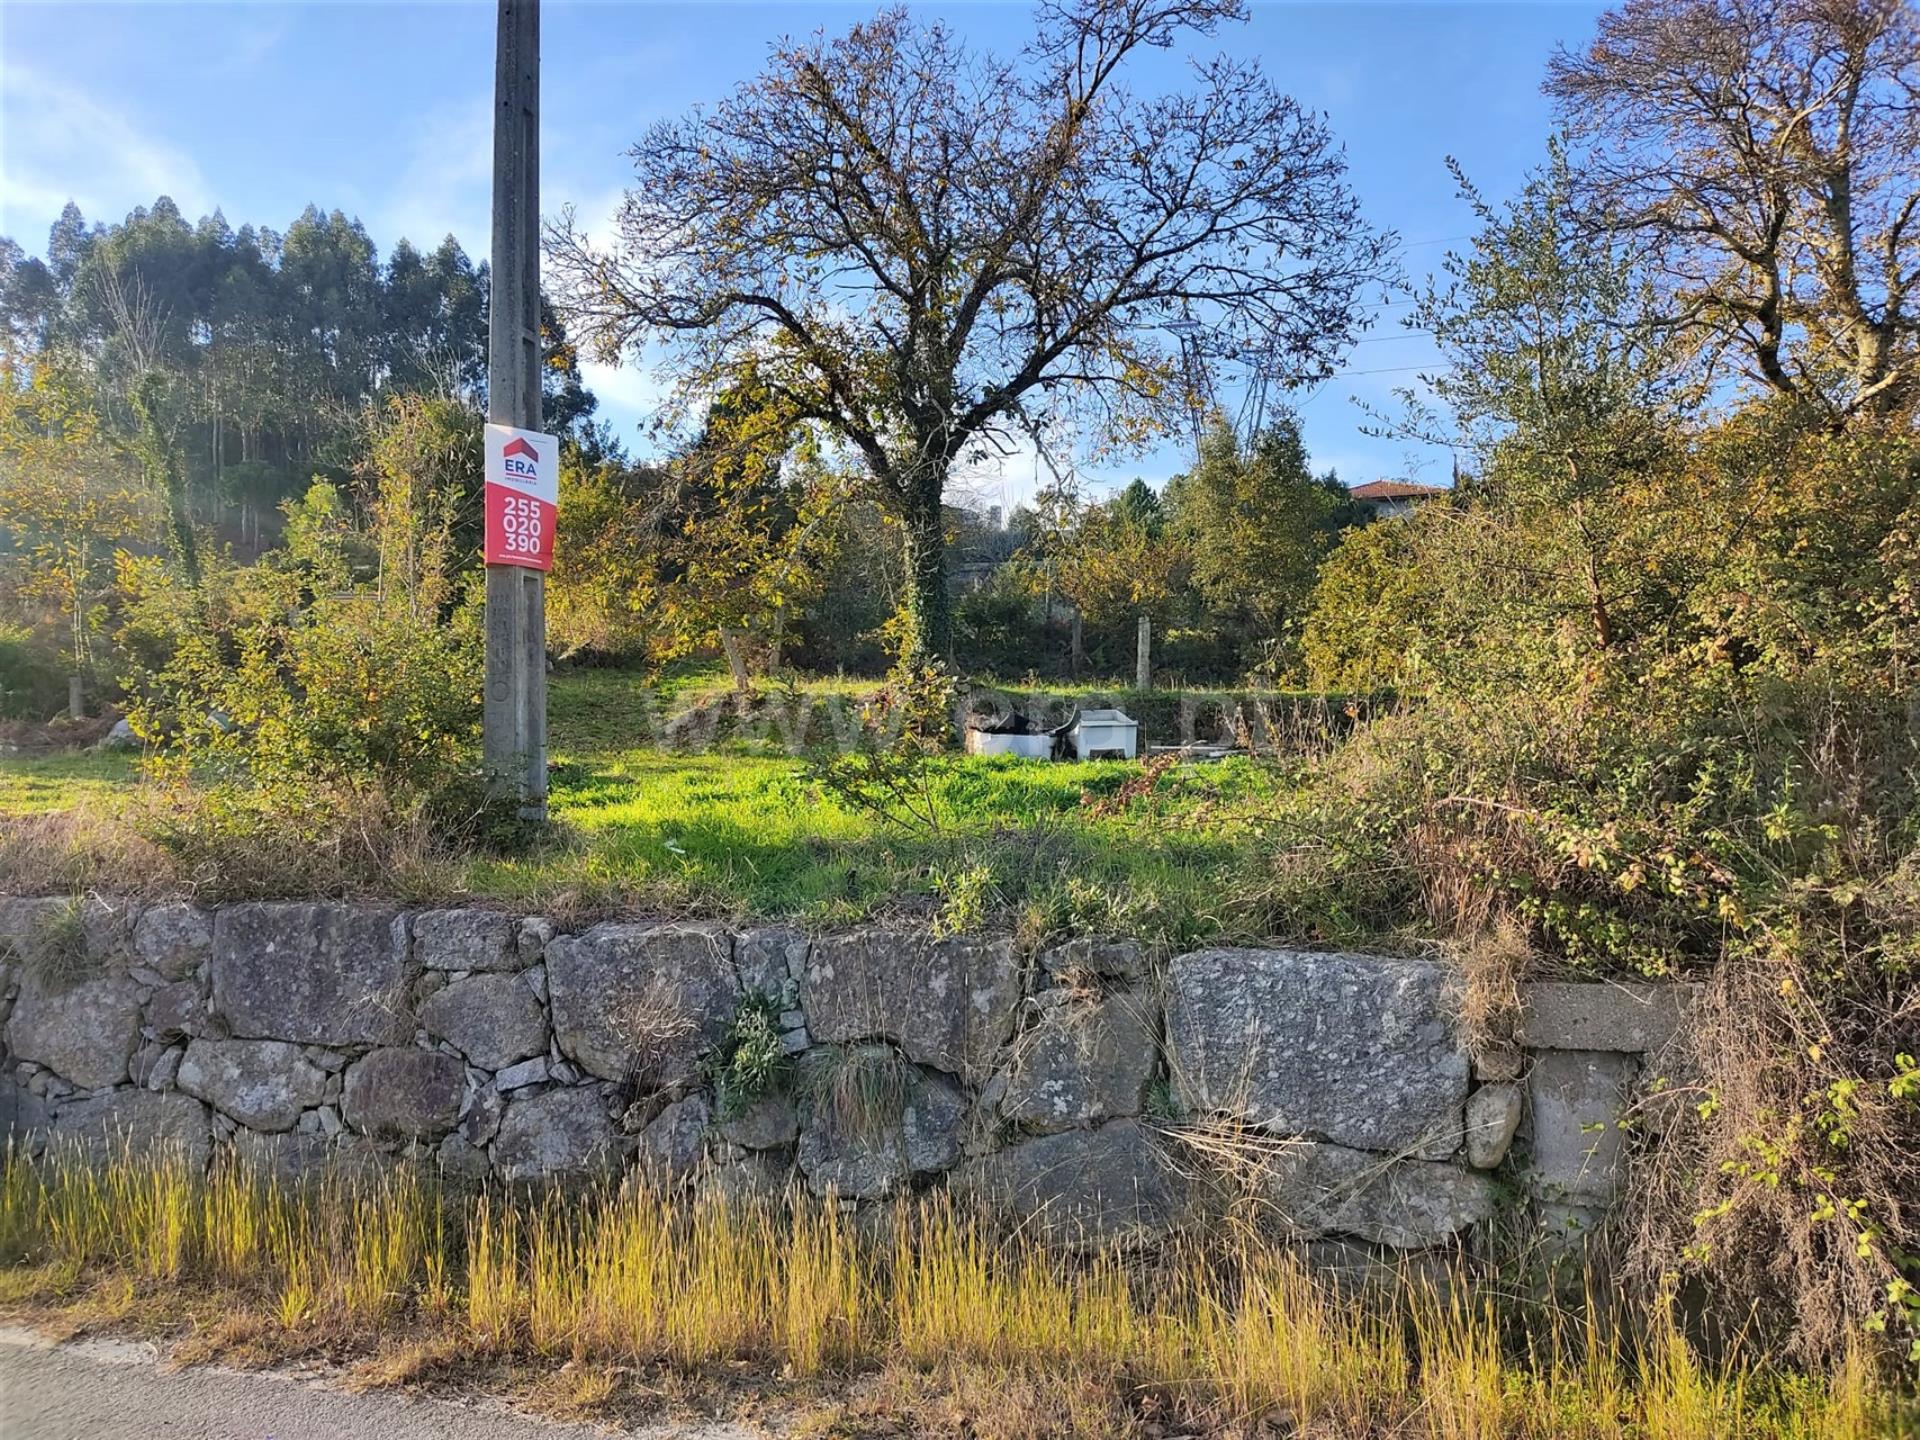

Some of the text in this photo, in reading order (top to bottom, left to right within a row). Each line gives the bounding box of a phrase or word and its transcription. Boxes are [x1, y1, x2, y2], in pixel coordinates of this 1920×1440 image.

[505, 459, 537, 476] ERA
[504, 497, 540, 518] 255
[503, 515, 541, 536] 020
[505, 532, 540, 554] 390
